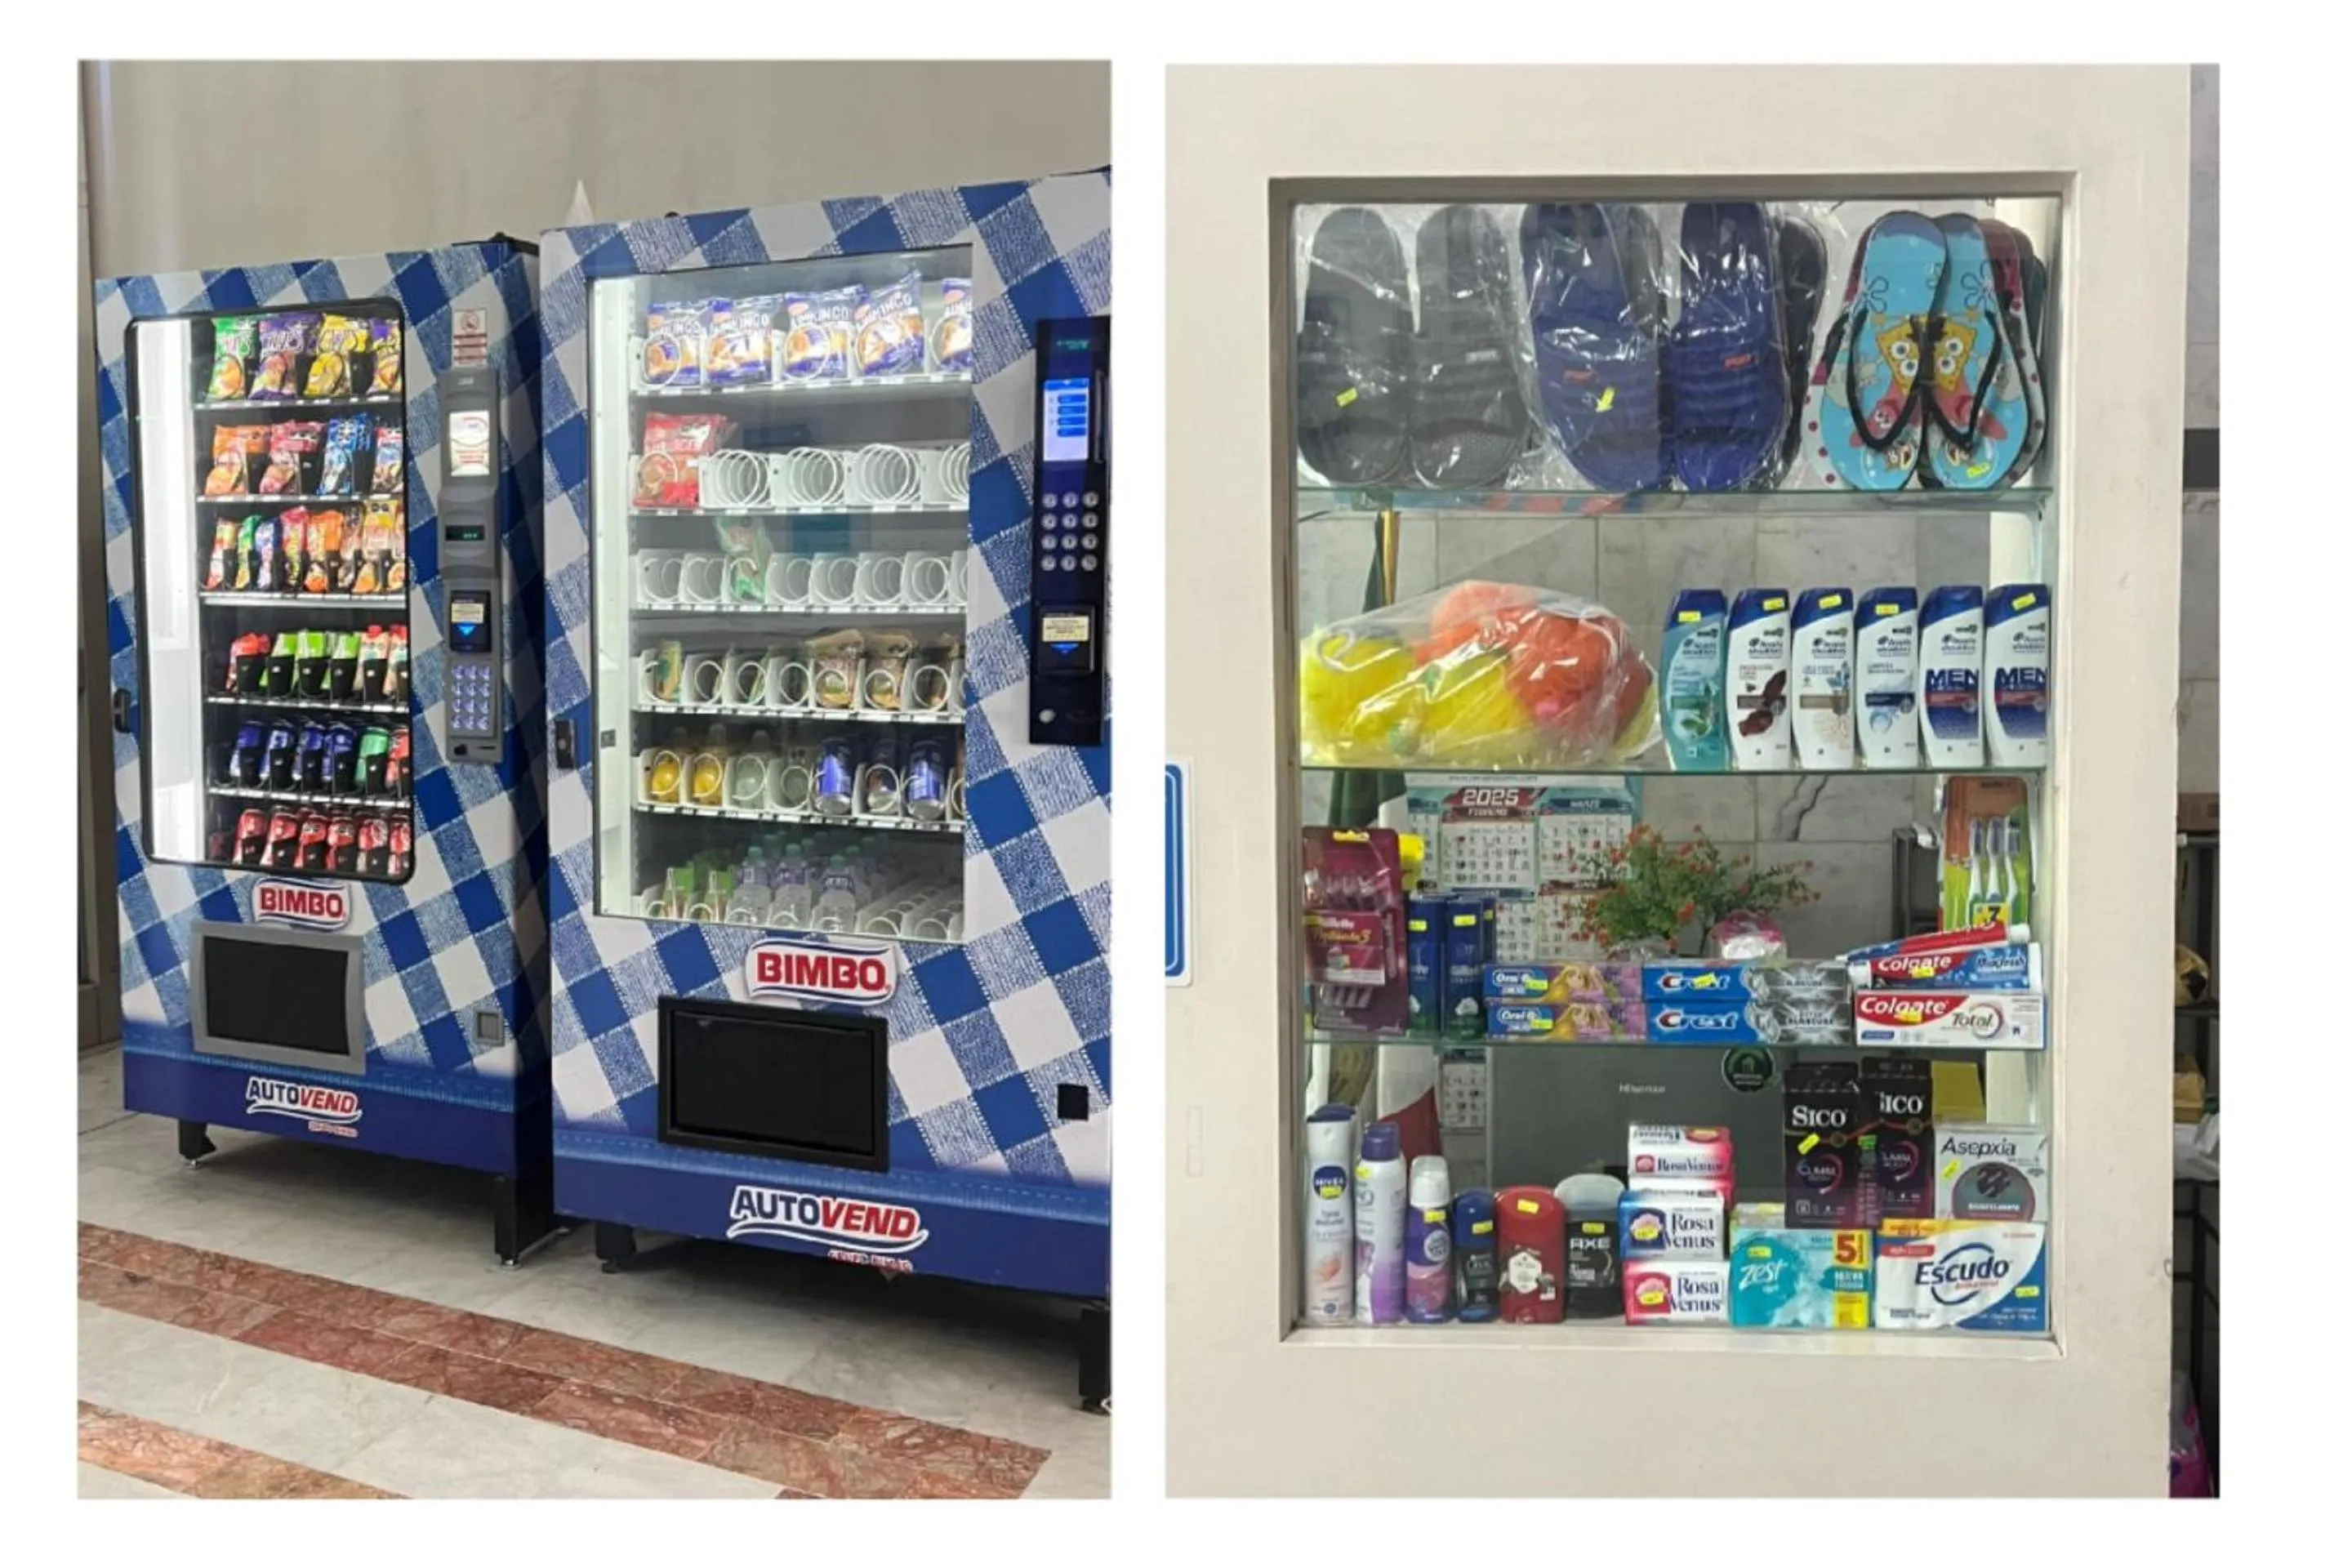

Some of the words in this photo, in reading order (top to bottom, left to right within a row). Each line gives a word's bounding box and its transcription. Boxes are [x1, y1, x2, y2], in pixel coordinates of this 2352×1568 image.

[1925, 668, 1980, 690] MEN
[1462, 789, 1519, 806] 2025
[260, 887, 344, 919] BIMBO
[757, 952, 887, 991] BIMBO
[1878, 955, 1952, 973] Colgate
[1659, 973, 1731, 991] Crt
[1860, 996, 1947, 1016] Colgate
[1656, 1010, 1740, 1031] Crest
[1952, 1012, 1994, 1028] Total
[249, 1079, 357, 1114] AUTOVEND
[1619, 1083, 1666, 1094] Hisense
[1940, 1135, 2016, 1158] Asepxia
[735, 1188, 918, 1239] AUTOVEND
[1672, 1213, 1714, 1232] Rosa
[1570, 1237, 1610, 1250] AXE
[1665, 1232, 1716, 1249] Venus
[1836, 1233, 1857, 1263] 5
[1915, 1256, 2010, 1285] Escudo
[1677, 1276, 1719, 1295] Rosa
[1669, 1296, 1722, 1313] Venus
